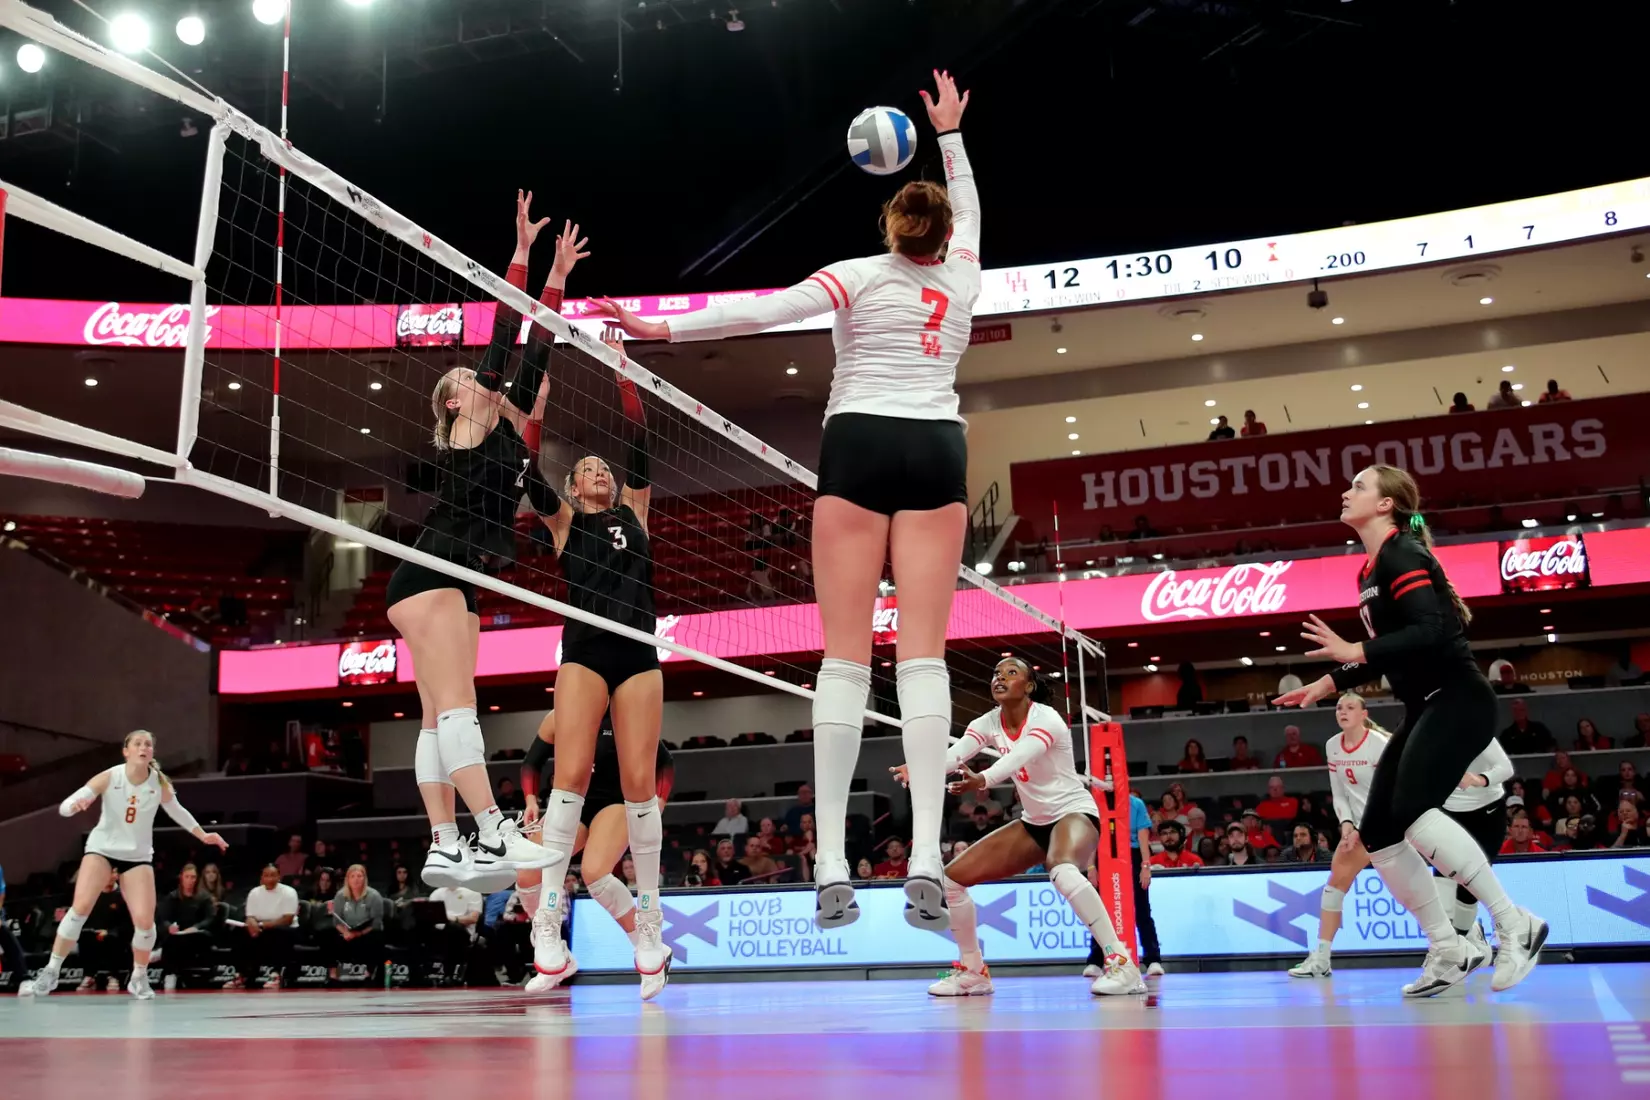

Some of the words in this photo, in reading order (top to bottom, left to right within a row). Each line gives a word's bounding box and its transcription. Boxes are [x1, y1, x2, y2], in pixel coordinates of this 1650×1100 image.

[1320, 251, 1366, 270] .200
[1417, 243, 1428, 256] 7
[1464, 235, 1474, 248] 1
[1523, 225, 1535, 240] 7
[1604, 211, 1618, 226] 8
[1043, 267, 1080, 289] 12
[1106, 254, 1172, 280] 1:30
[1205, 248, 1242, 271] 10
[1193, 280, 1201, 290] 2
[658, 296, 690, 311] ACES
[921, 287, 949, 332] 7
[1023, 299, 1030, 309] 2
[1081, 448, 1331, 510] HOUSTON
[1341, 418, 1608, 481] COUGARS
[607, 526, 628, 550] 3
[1501, 540, 1586, 580] Coca-Cola
[1141, 560, 1293, 621] Coca-Cola
[1359, 586, 1379, 604] STON
[1520, 670, 1583, 681] HOUSTON
[1345, 768, 1358, 784] 9
[125, 807, 137, 824] 8
[1111, 872, 1122, 900] sports
[1354, 876, 1383, 895] LO
[1029, 889, 1067, 907] LOV
[1113, 901, 1125, 935] imports
[728, 938, 848, 957] VOLLEYBALL
[1029, 931, 1092, 949] VOLLE
